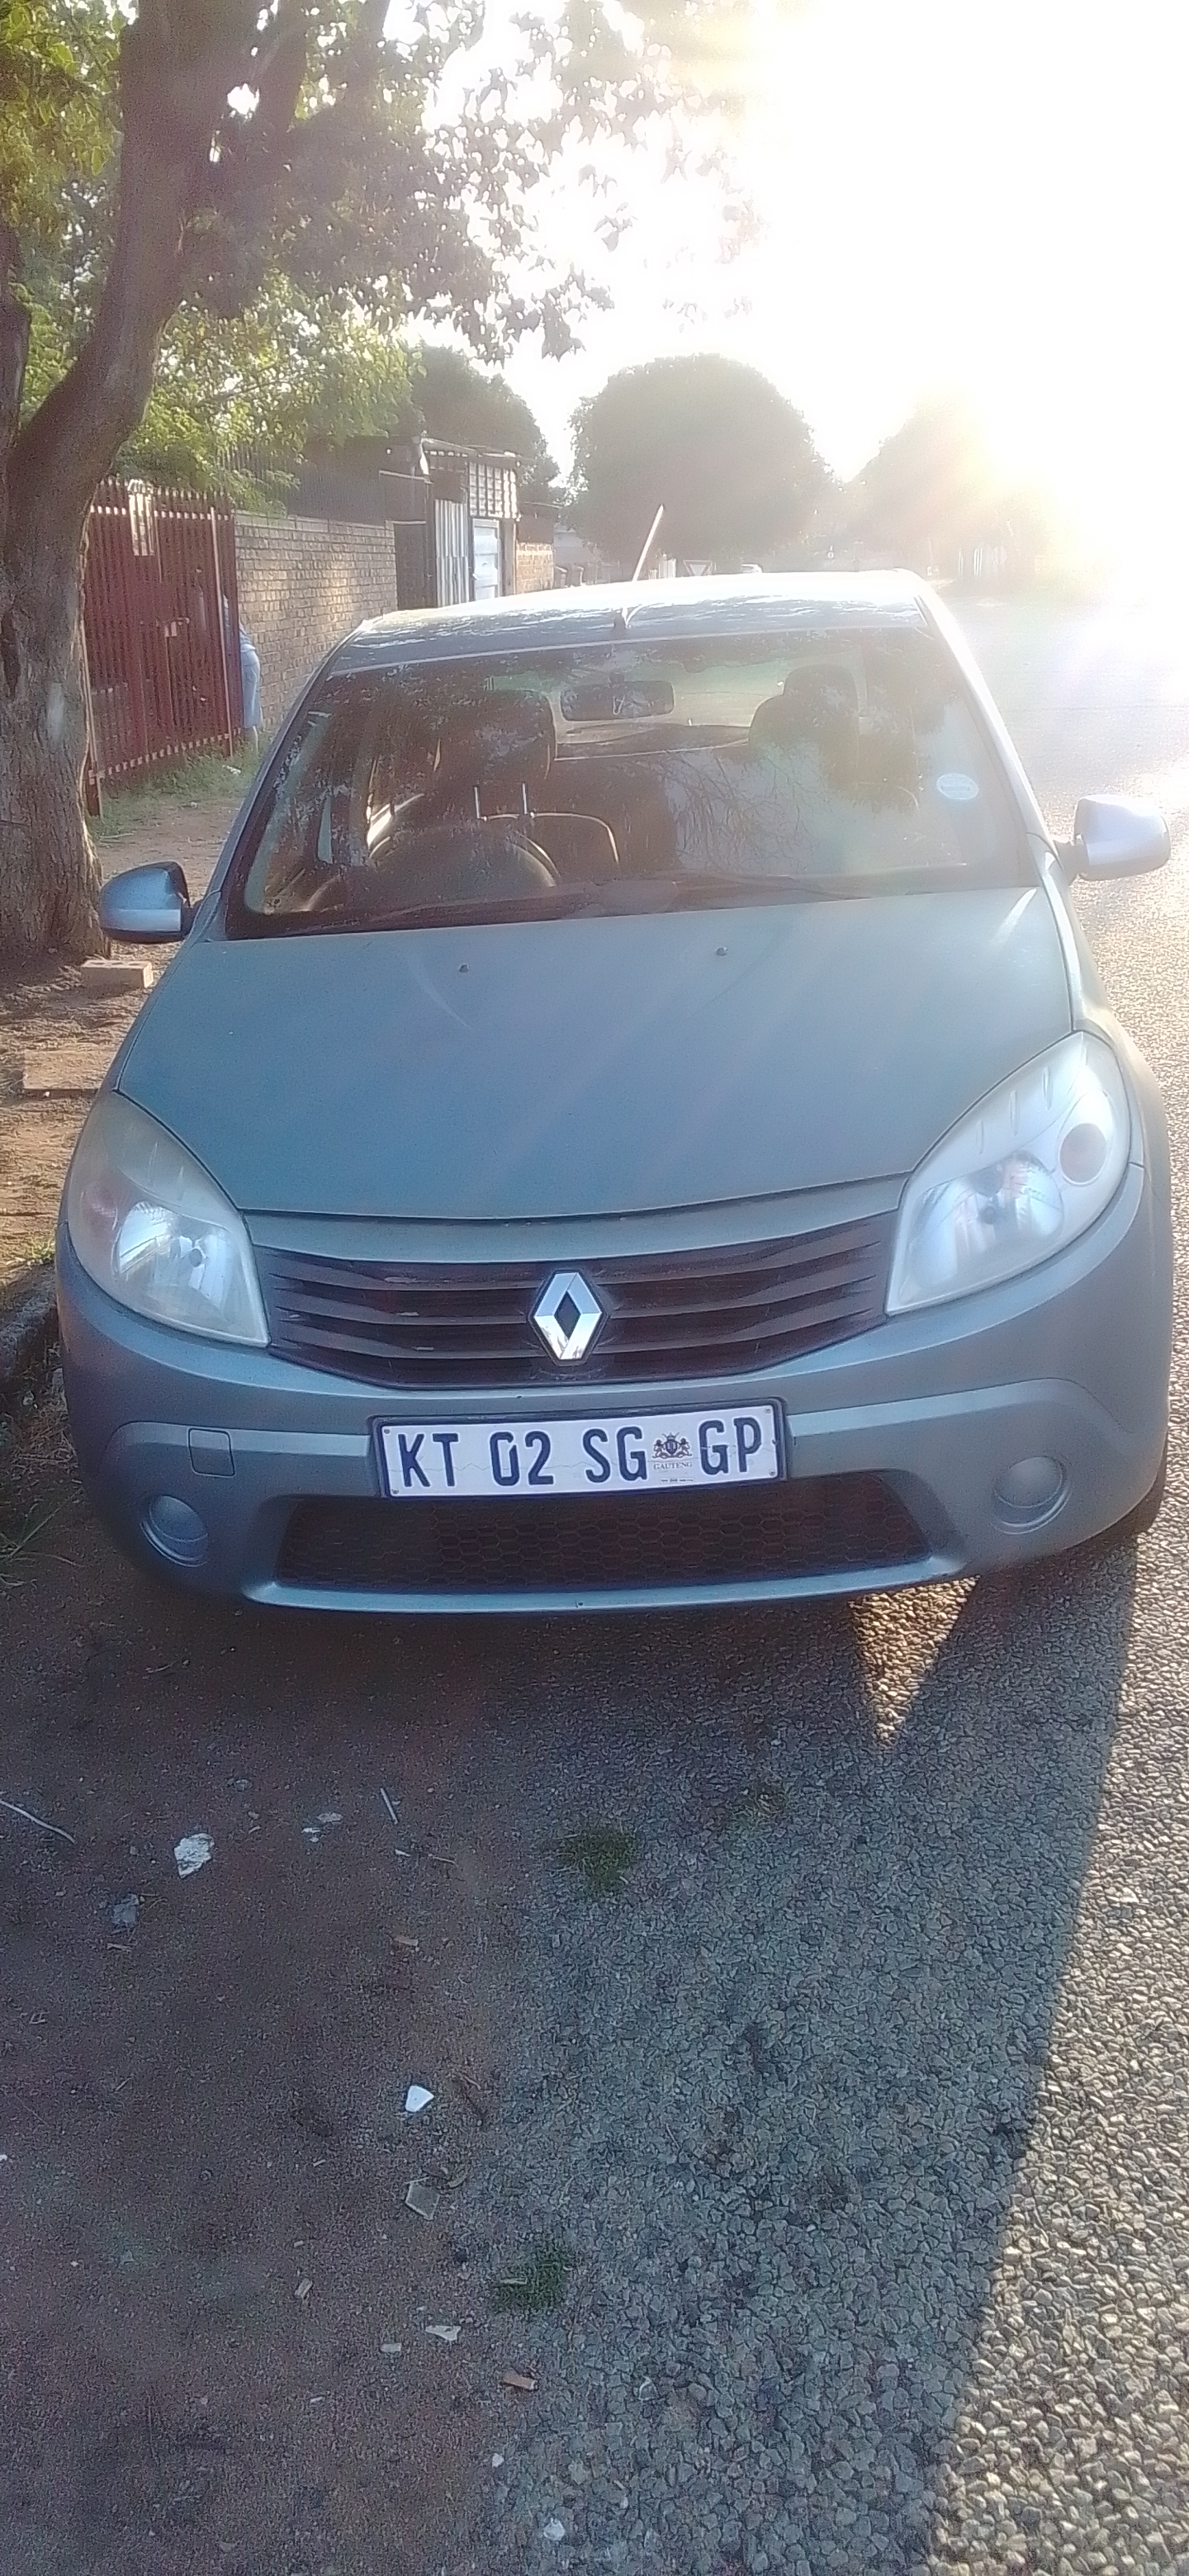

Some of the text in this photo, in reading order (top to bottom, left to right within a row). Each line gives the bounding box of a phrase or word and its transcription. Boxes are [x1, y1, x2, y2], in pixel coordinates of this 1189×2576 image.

[397, 1416, 761, 1488] KT 02 SG GP
[653, 1461, 693, 1470] GAUTENG
